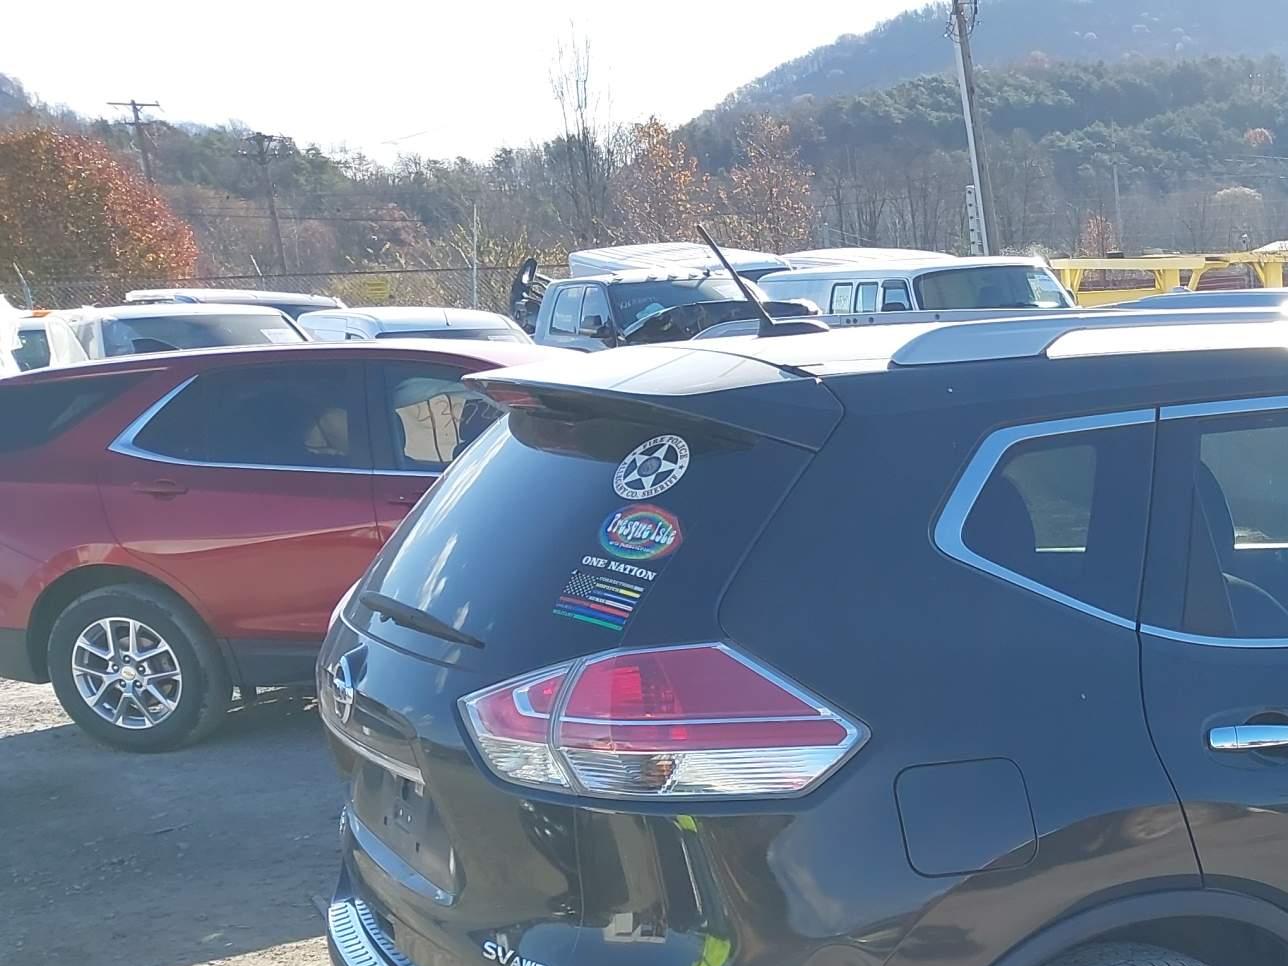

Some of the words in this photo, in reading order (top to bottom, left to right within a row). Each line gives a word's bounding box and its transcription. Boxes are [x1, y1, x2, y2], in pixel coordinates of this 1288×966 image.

[641, 436, 667, 450] FIRE
[667, 435, 689, 460] POLICE
[641, 473, 678, 498] SHERIFF
[606, 512, 653, 541] Presque
[649, 521, 678, 545] Isle
[581, 555, 608, 568] ONE
[607, 560, 657, 581] NATION
[482, 940, 516, 966] SV
